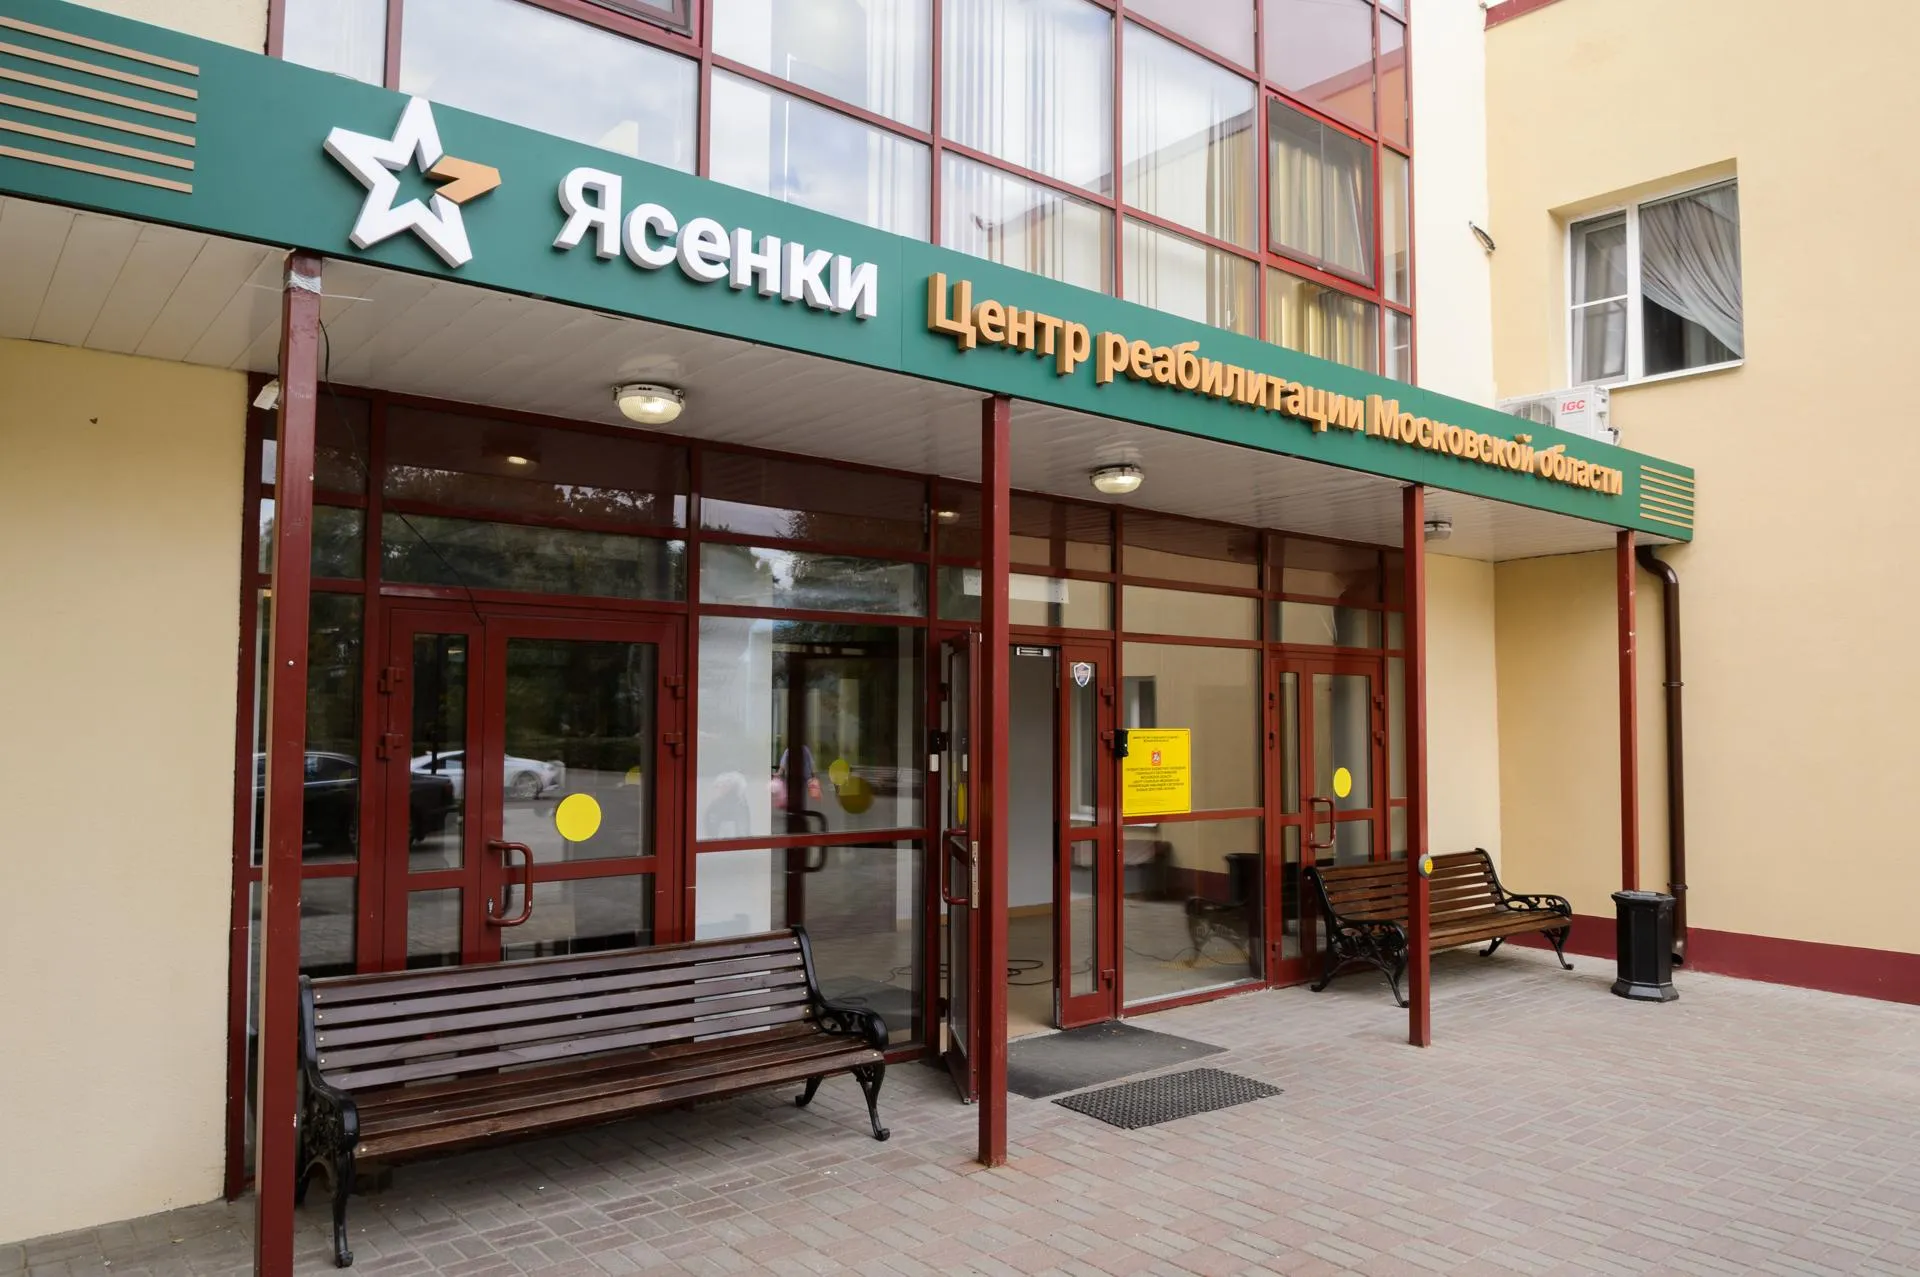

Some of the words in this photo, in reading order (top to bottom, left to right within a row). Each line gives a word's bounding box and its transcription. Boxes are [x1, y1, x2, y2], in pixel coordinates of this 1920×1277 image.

[553, 167, 878, 319] Ясенки
[928, 272, 1090, 376] Центр
[1096, 331, 1364, 433] реабилитации
[1366, 394, 1534, 473] Московской
[1534, 444, 1623, 495] области
[1561, 400, 1585, 412] IGC
